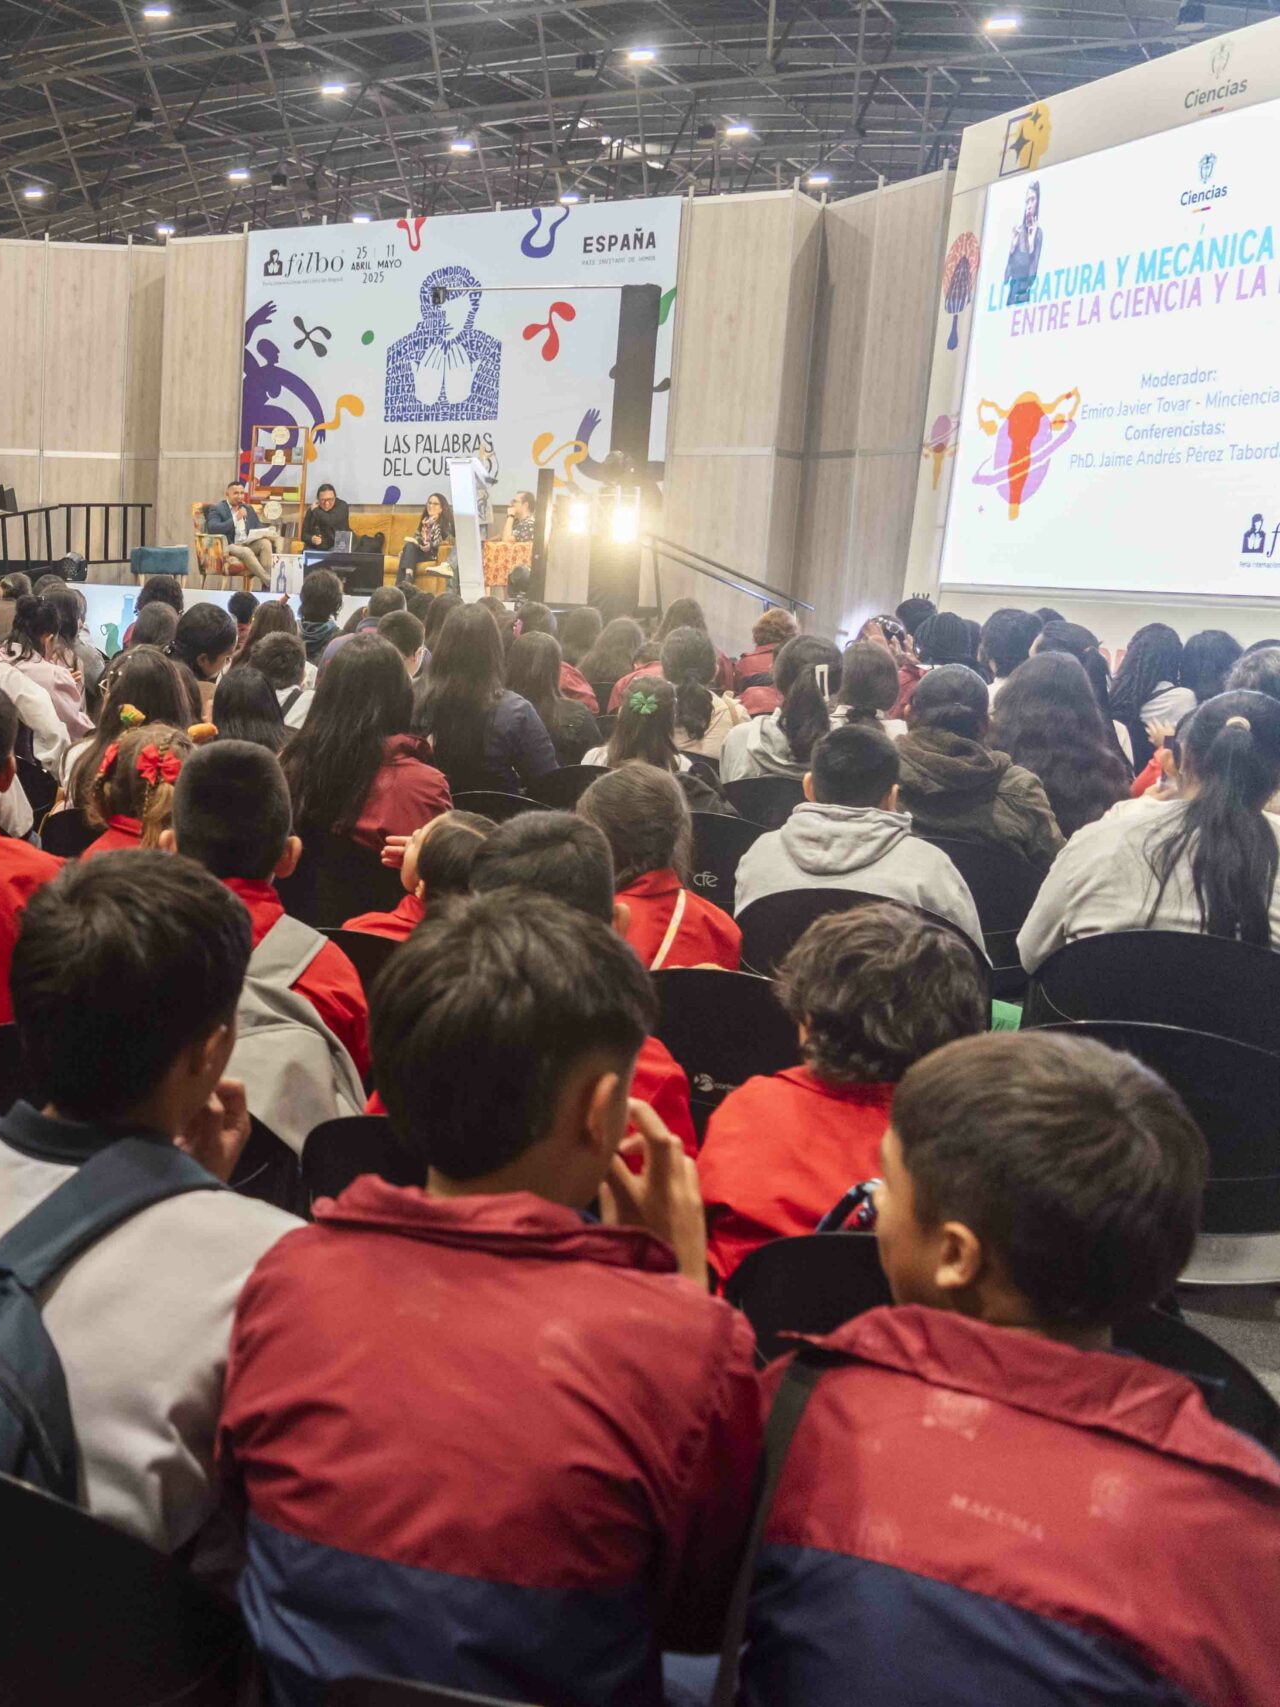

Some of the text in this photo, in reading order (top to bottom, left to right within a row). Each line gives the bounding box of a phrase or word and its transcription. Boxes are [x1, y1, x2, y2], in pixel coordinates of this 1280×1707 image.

[1184, 77, 1248, 110] Ciencias
[1180, 184, 1228, 206] Ciencias
[583, 227, 656, 254] ESPAÑA
[356, 244, 395, 259] 25 11
[1117, 255, 1130, 288] Y
[1135, 223, 1274, 285] MECÁNICA
[285, 252, 345, 278] filbo
[351, 259, 402, 271] ABRIL MAYO
[362, 271, 385, 284] 2025
[1010, 300, 1072, 337] ENTRE
[1077, 295, 1101, 327] LA
[1109, 276, 1202, 321] CIENCIA
[1214, 271, 1228, 304] Y
[1235, 264, 1267, 301] LA
[1140, 367, 1218, 390] Moderador:
[385, 384, 416, 397] FUERZA
[384, 401, 440, 415] TRANQUILIDAD
[384, 411, 441, 423] CONSCIENTE
[1080, 403, 1115, 420] Emiro
[1117, 400, 1152, 417] Javier
[1157, 397, 1191, 413] Tovar
[1124, 420, 1226, 441] Conferencistas:
[384, 432, 494, 454] LAS PALABRAS
[1136, 447, 1182, 466] Andrés
[1186, 445, 1224, 463] Pérez
[383, 457, 413, 477] DEL
